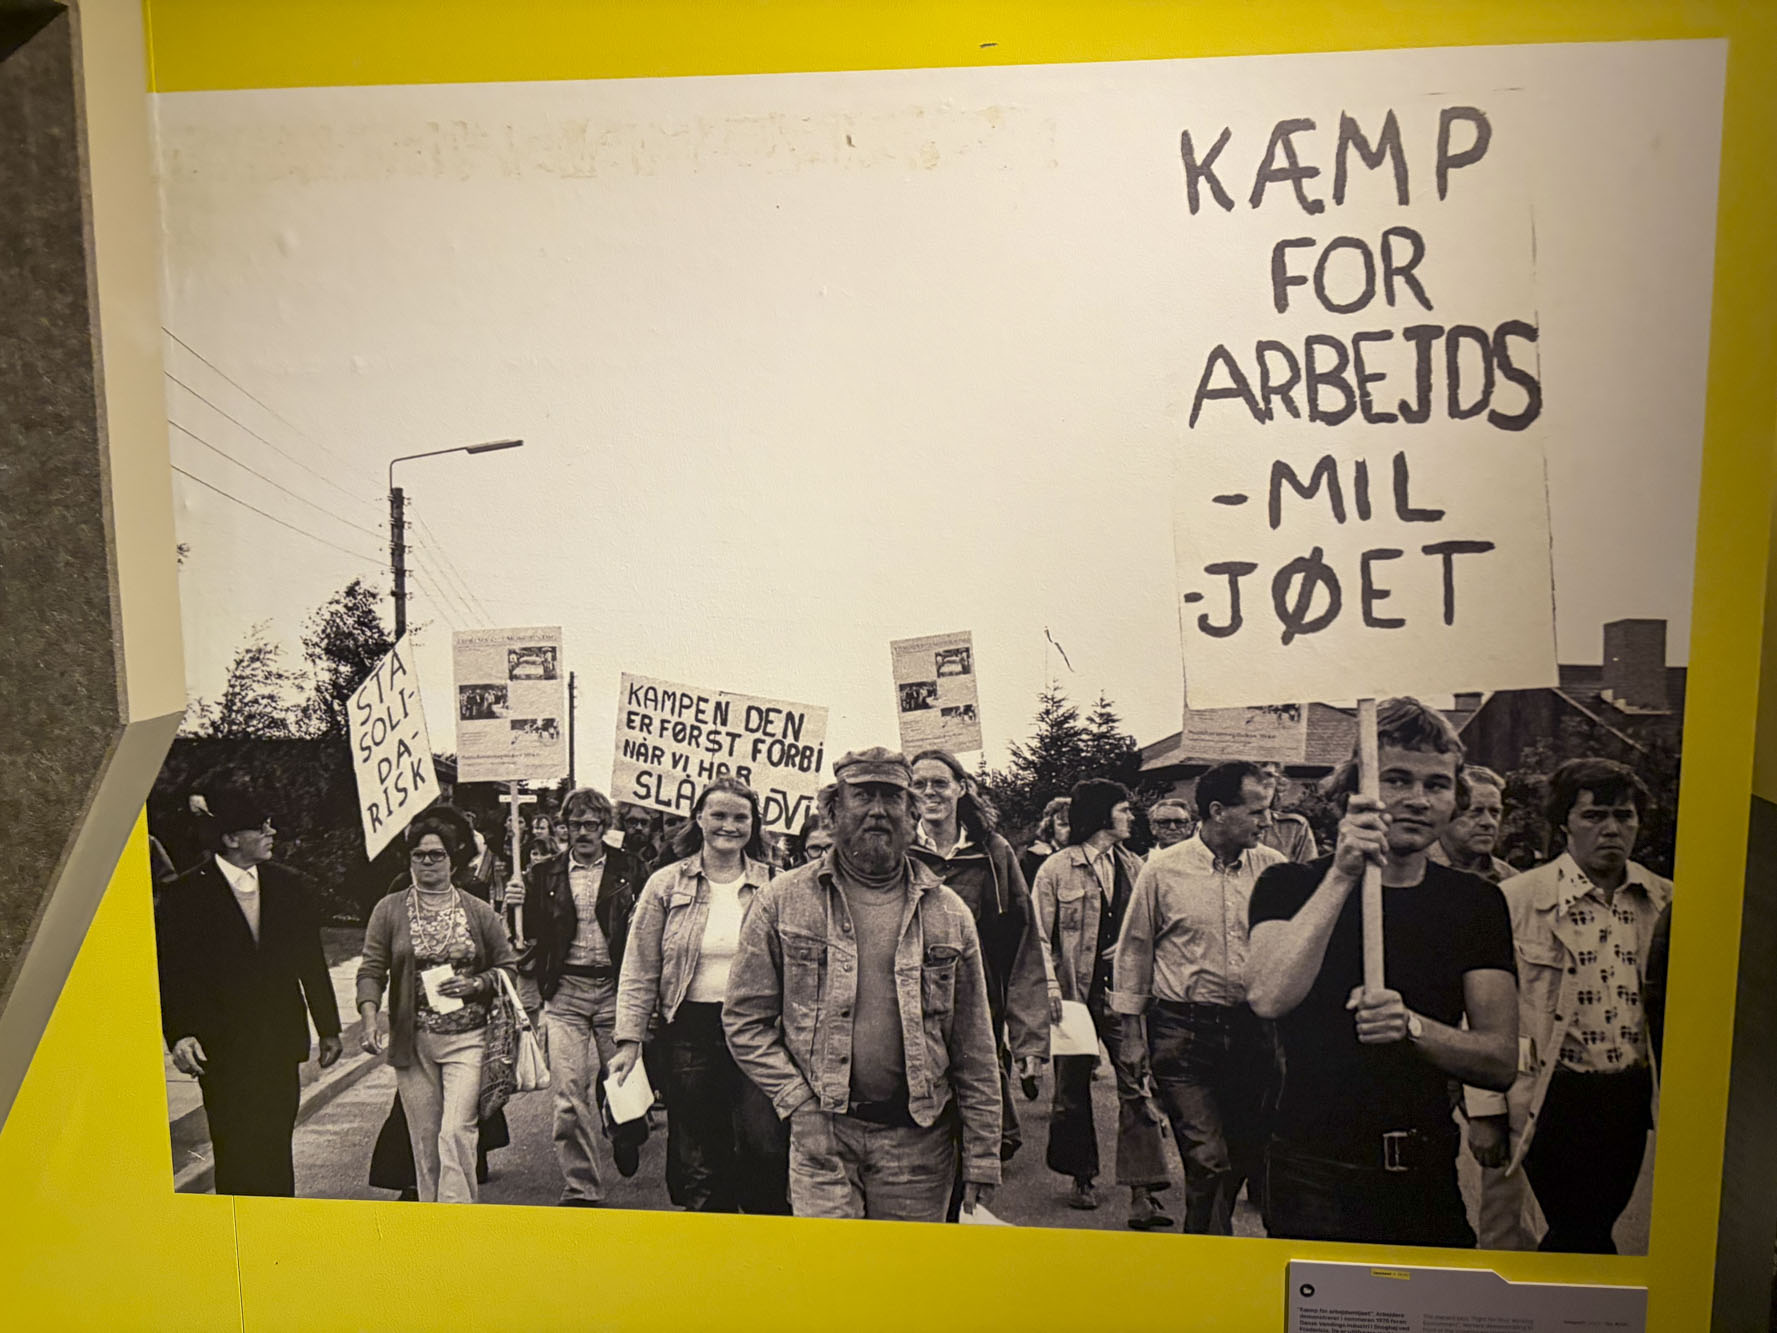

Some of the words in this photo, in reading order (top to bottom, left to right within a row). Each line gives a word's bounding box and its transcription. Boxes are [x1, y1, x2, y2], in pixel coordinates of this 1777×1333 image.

[1180, 105, 1493, 216] KÆMP
[1271, 226, 1434, 314] FOR
[1188, 319, 1543, 432] ARBEJDS
[360, 688, 415, 764] SOLI-
[626, 710, 653, 735] ER
[659, 718, 742, 757] FØRST
[627, 682, 730, 727] KAMPEN
[744, 705, 805, 742] DEN
[378, 731, 420, 785] DA-
[623, 737, 665, 766] NÅR
[672, 751, 690, 773] VI
[367, 758, 426, 833] RISK
